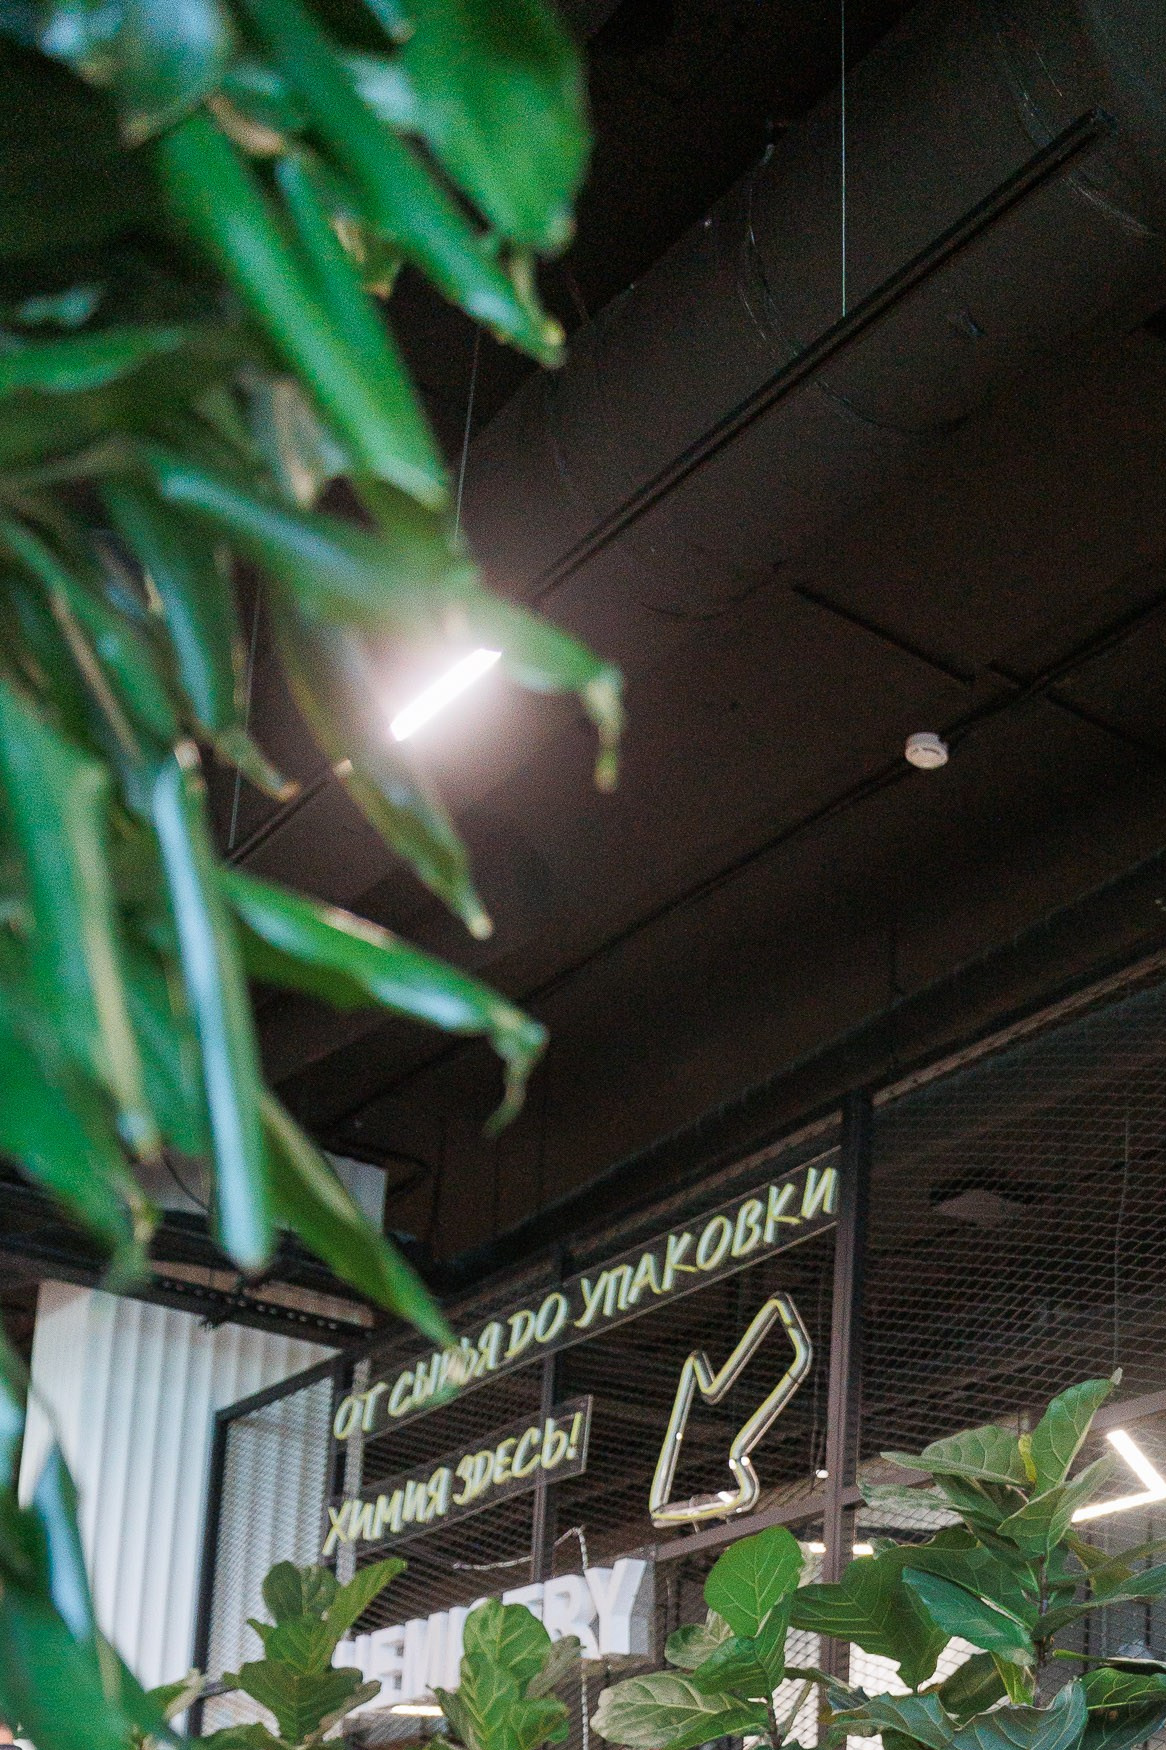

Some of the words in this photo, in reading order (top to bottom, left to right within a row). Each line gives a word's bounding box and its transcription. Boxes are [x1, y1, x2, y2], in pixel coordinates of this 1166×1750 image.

[333, 1381, 388, 1441] ОТ
[503, 1291, 569, 1358] ДО
[573, 1166, 839, 1329] УПАКОВКИ
[322, 1467, 451, 1557] ХИМИЯ
[452, 1411, 584, 1505] ЗДЕСЬ!
